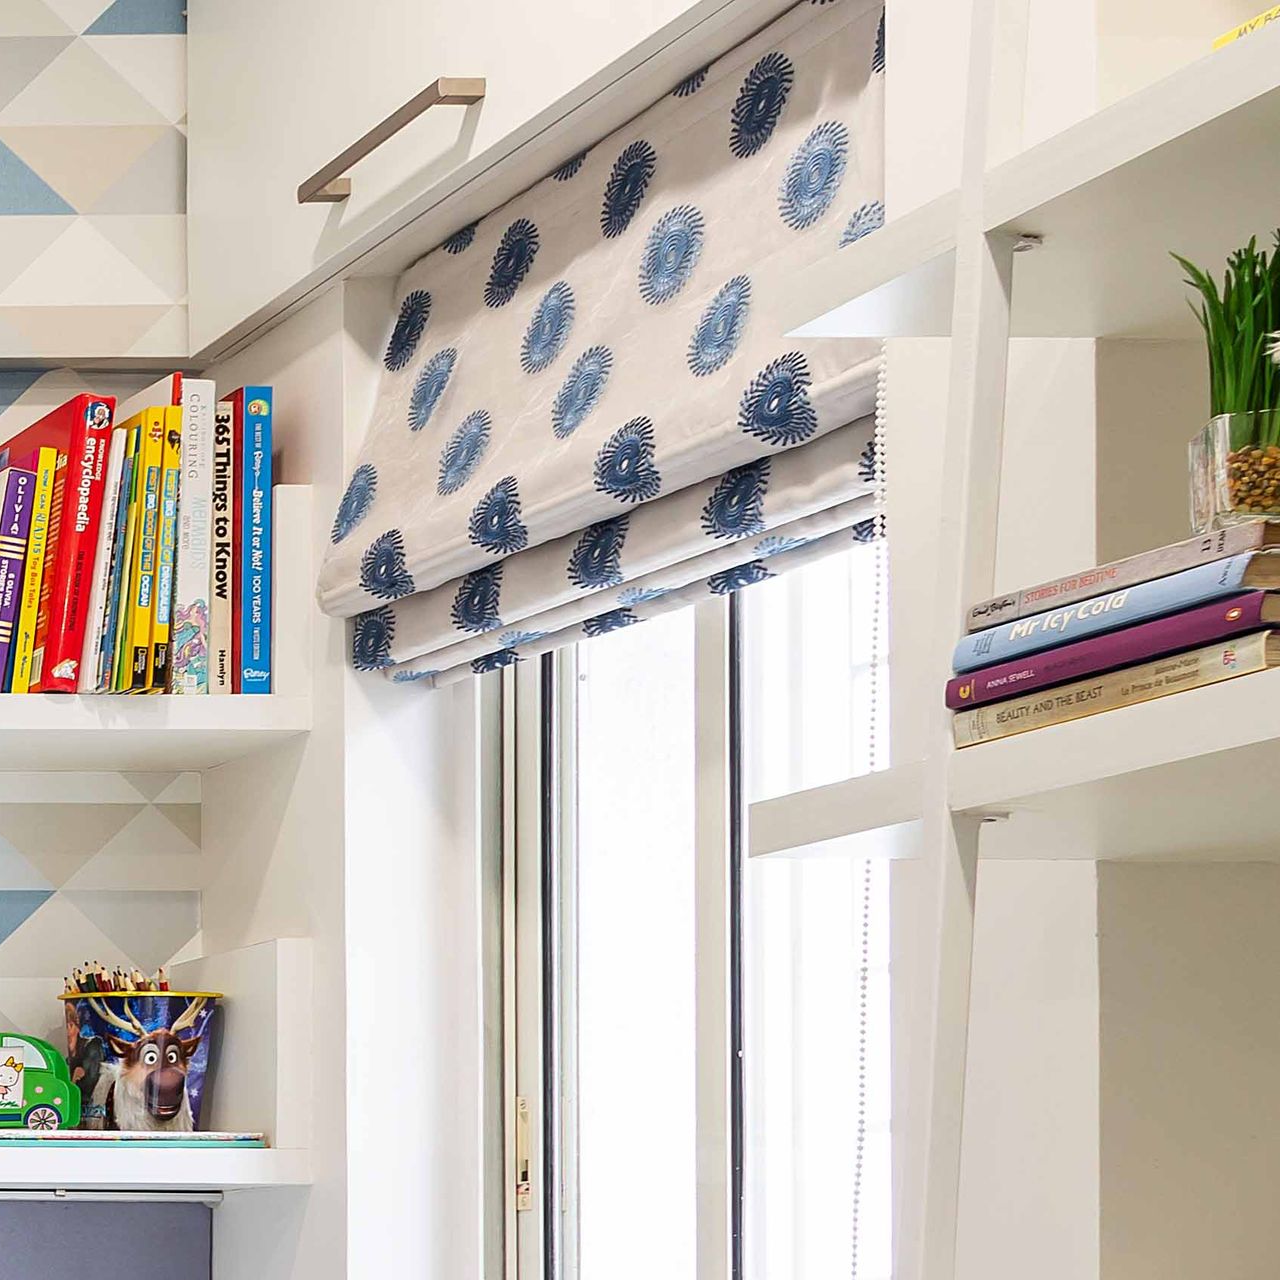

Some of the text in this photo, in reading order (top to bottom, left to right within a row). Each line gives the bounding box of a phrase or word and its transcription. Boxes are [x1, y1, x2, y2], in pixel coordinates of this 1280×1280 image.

[189, 394, 200, 479] COLOURING
[96, 439, 106, 480] KNOWLEDGE
[75, 437, 96, 533] encyclopaedia
[146, 494, 156, 508] BIG
[10, 476, 28, 534] OLIVIA
[164, 501, 175, 516] BIG
[212, 414, 231, 599] 365 Things to Know
[252, 489, 263, 524] Believe
[251, 549, 263, 571] Not!
[139, 576, 151, 607] OCEAN
[158, 567, 171, 621] DINOSAURS
[252, 575, 261, 593] 100
[1024, 568, 1117, 604] STORIES FOR BEDTIME
[252, 595, 261, 624] YEARS
[1009, 590, 1131, 641] Mr Icy Cold
[218, 650, 227, 686] Hamlyn
[986, 669, 1036, 689] ANNA SEWELL
[996, 706, 1031, 724] BEAUTY
[1032, 699, 1054, 715] AND
[1056, 692, 1074, 706] THE
[1076, 686, 1104, 703] BEAST
